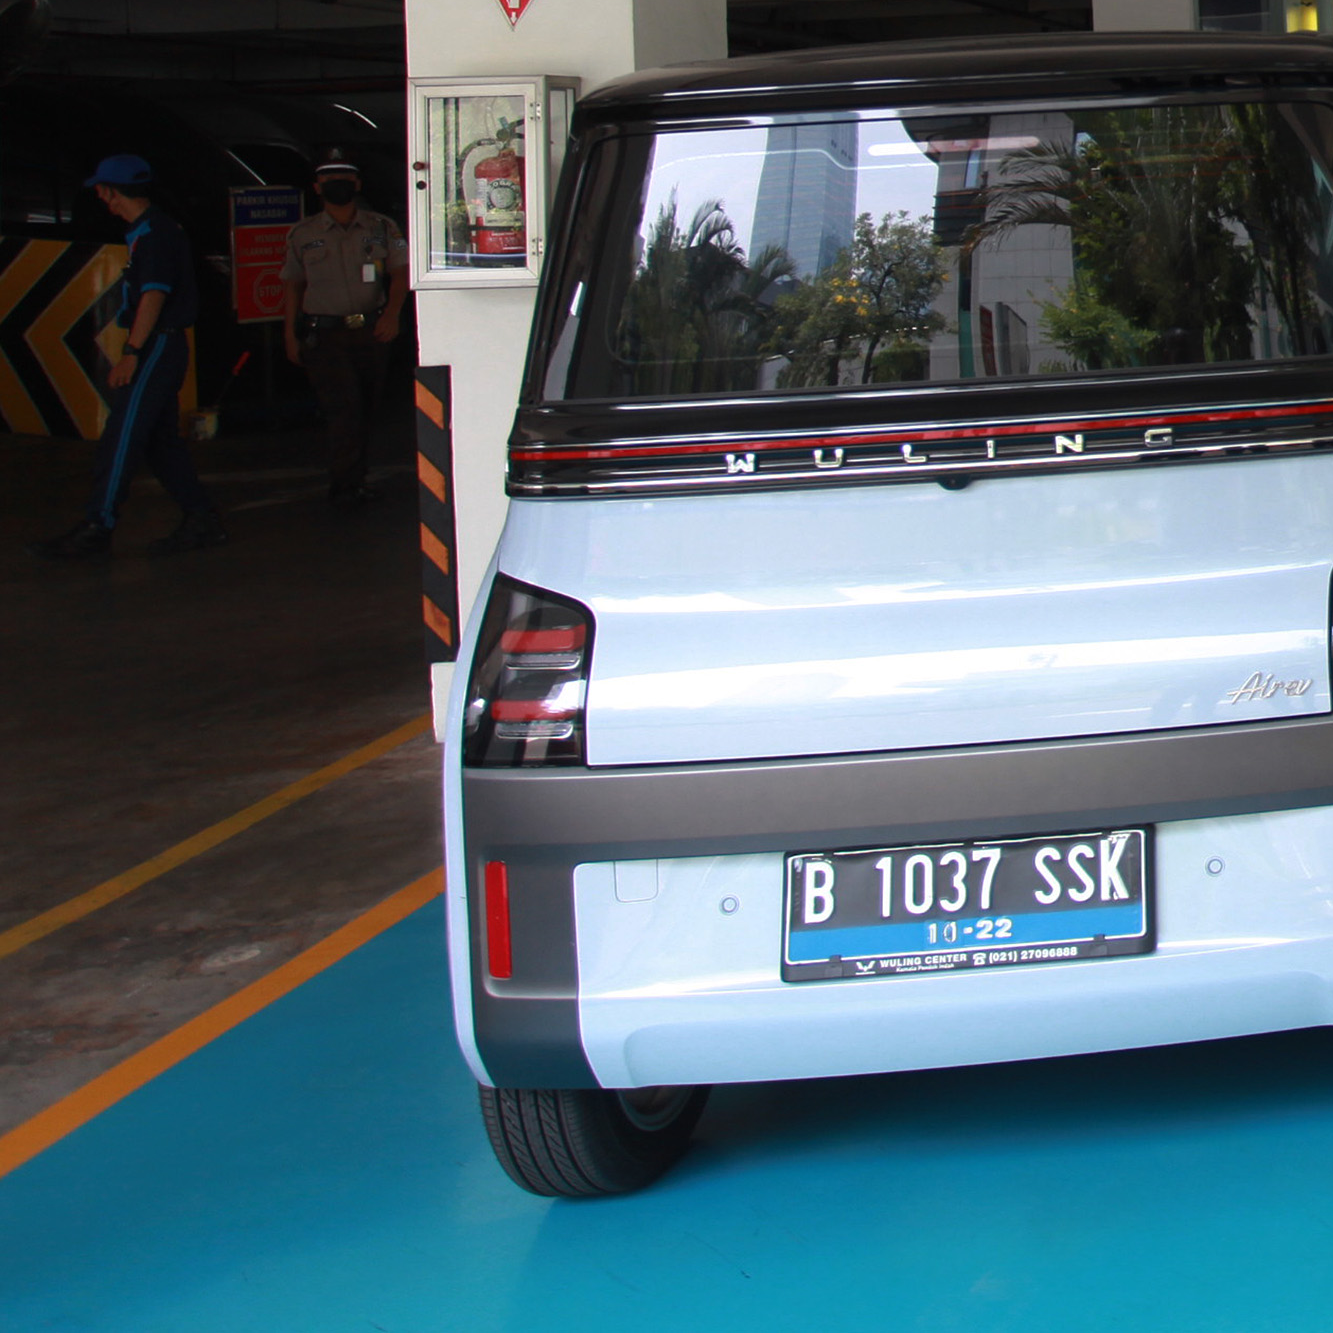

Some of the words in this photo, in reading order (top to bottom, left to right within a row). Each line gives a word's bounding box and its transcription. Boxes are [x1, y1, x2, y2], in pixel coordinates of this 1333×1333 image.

[725, 427, 1173, 474] WULING
[804, 860, 835, 924] B
[875, 848, 1001, 919] 1037
[1034, 833, 1132, 905] SSK
[880, 956, 922, 969] WULING
[924, 953, 967, 965] CENTER
[988, 949, 1018, 964] (021)
[1020, 946, 1078, 961] 27096888
